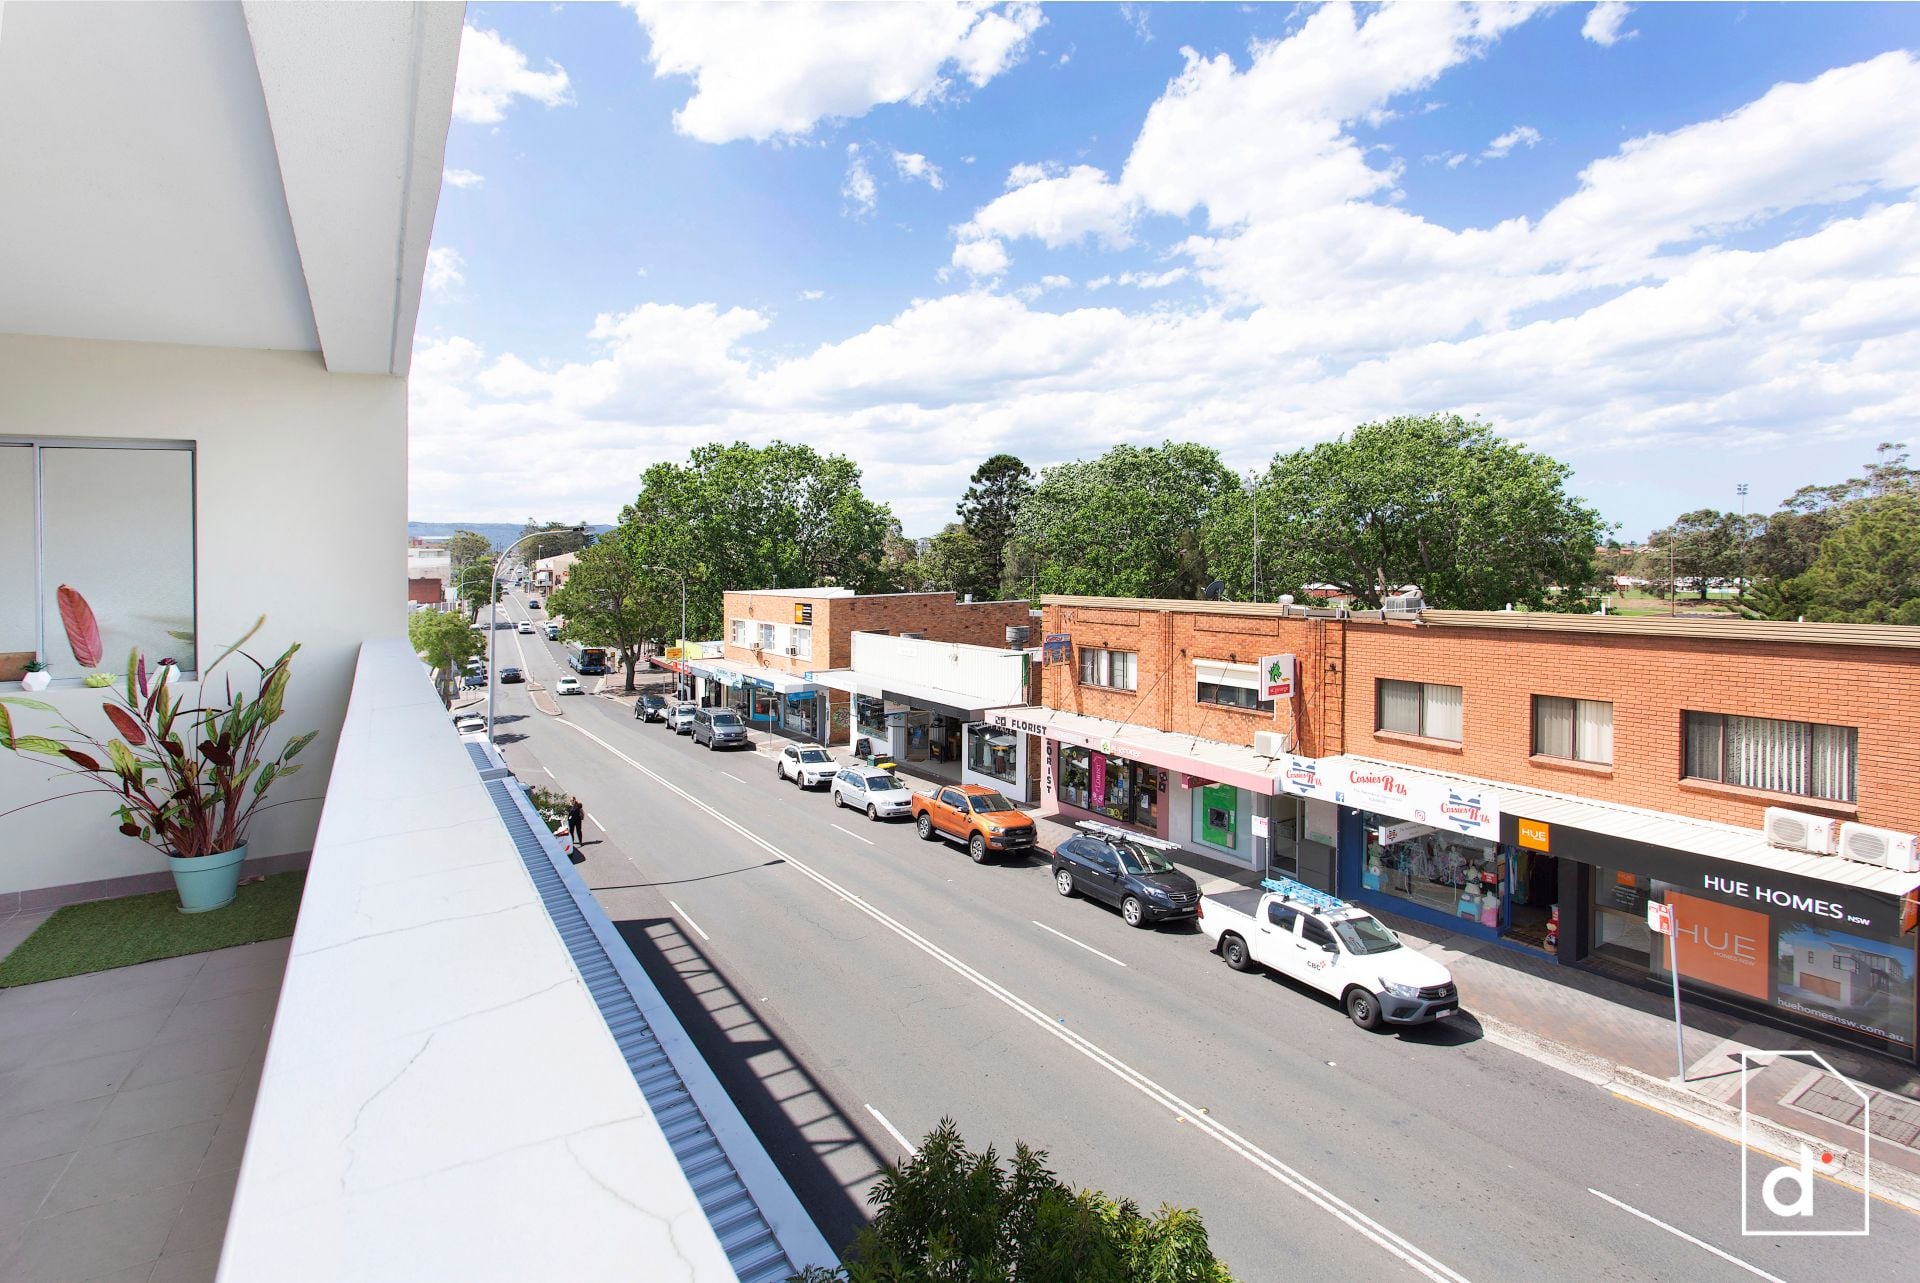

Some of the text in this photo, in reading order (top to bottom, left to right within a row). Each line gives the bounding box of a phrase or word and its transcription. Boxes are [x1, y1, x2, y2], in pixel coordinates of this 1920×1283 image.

[1011, 719, 1047, 736] FLORIST
[1349, 770, 1381, 784] Cossies
[1382, 775, 1394, 793] R
[1395, 783, 1407, 796] Us
[1521, 827, 1546, 839] HUE
[1704, 874, 1871, 926] HUE HOMES NSW
[1674, 919, 1757, 960] HUE
[1306, 960, 1321, 971] CBC
[1777, 997, 1905, 1042] huehomesnsw.com.au
